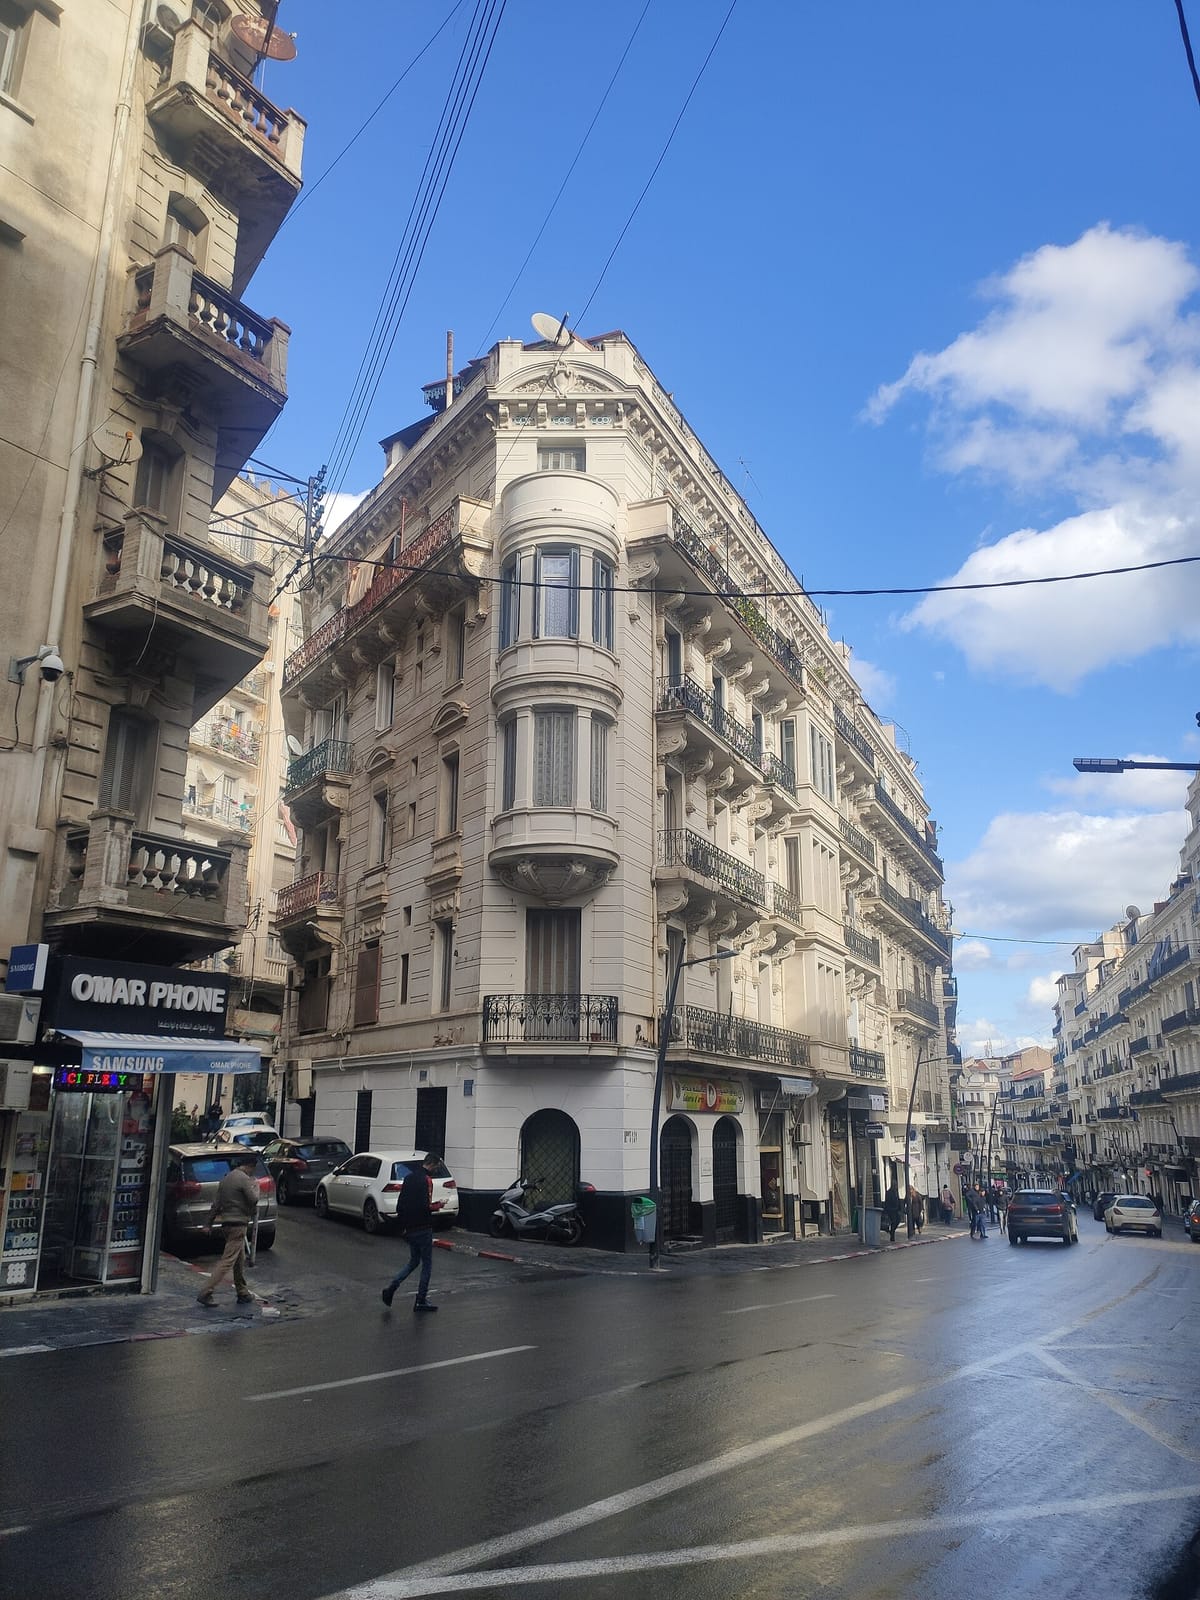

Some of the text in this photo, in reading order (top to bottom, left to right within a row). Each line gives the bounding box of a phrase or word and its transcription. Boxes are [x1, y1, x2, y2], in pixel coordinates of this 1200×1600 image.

[10, 962, 35, 973] SAMSUNG
[71, 973, 226, 1013] OMAR PHONE
[92, 1055, 165, 1072] SAMSUNG
[210, 1061, 252, 1070] OMAR PHONE
